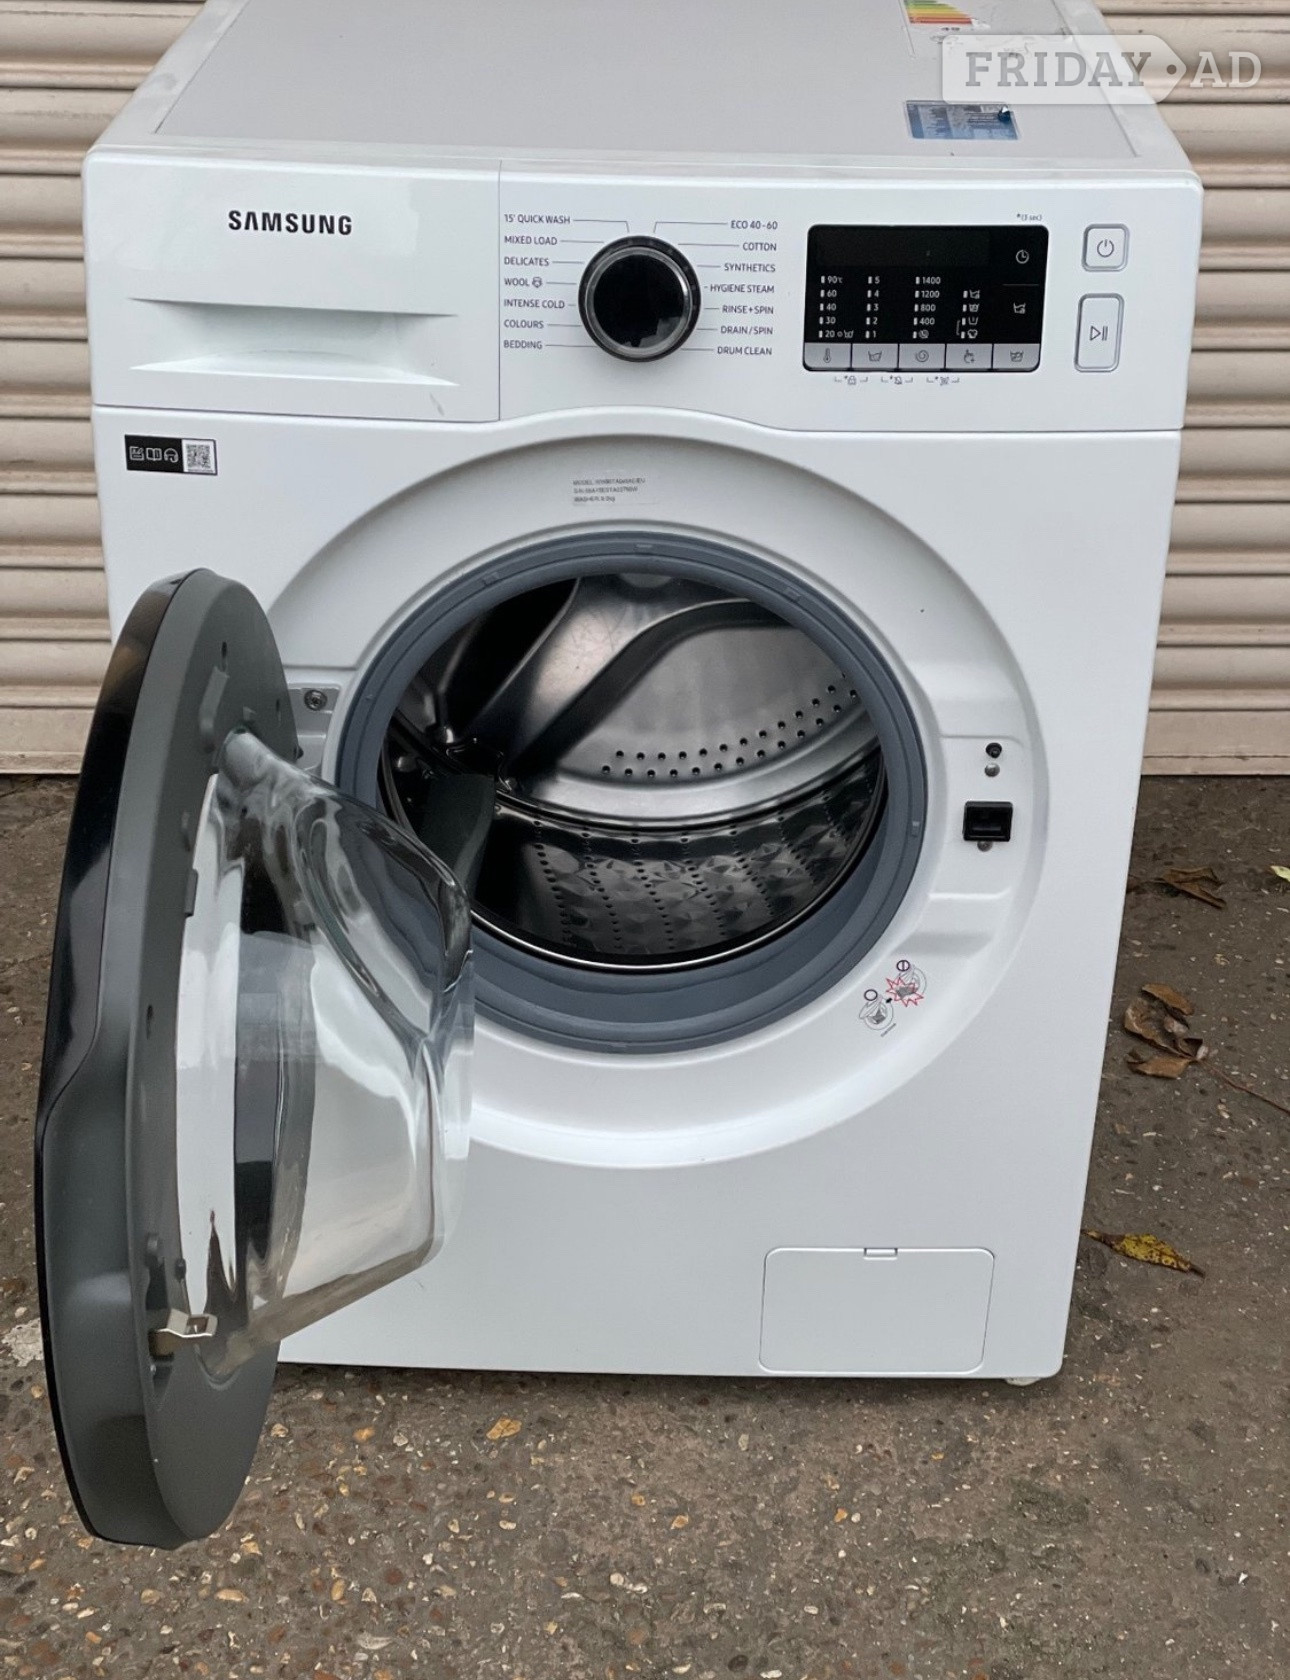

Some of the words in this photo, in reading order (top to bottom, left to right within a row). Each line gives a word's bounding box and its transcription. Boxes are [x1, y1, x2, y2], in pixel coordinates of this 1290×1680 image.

[228, 210, 352, 235] SAMSUNG
[517, 214, 544, 224] QUICK
[545, 215, 571, 224] WASH
[730, 220, 749, 229] ECO
[504, 235, 532, 245] MIXED
[533, 236, 558, 246] LOAD
[742, 242, 777, 251] COTTON
[503, 256, 549, 266] DELICATES
[724, 262, 776, 273] SYNTHETICS
[504, 278, 530, 287] WOOL
[874, 276, 880, 284] 5
[922, 276, 941, 285] 1400
[710, 283, 745, 293] HYGIENE
[746, 284, 774, 294] STEAM
[826, 289, 837, 298] 60
[873, 289, 880, 298] 4
[921, 290, 940, 299] 1200
[503, 299, 540, 308] INTENSE
[541, 300, 565, 309] COLD
[826, 302, 837, 311] 40
[873, 303, 879, 311] 3
[920, 303, 936, 312] 800
[503, 319, 545, 329] COLOURS
[825, 316, 836, 325] 30
[872, 317, 878, 325] 2
[919, 317, 935, 326] 400
[825, 330, 836, 338] 20
[503, 340, 543, 350] BEDDING
[717, 346, 742, 355] DRUM
[744, 347, 772, 356] CLEAN
